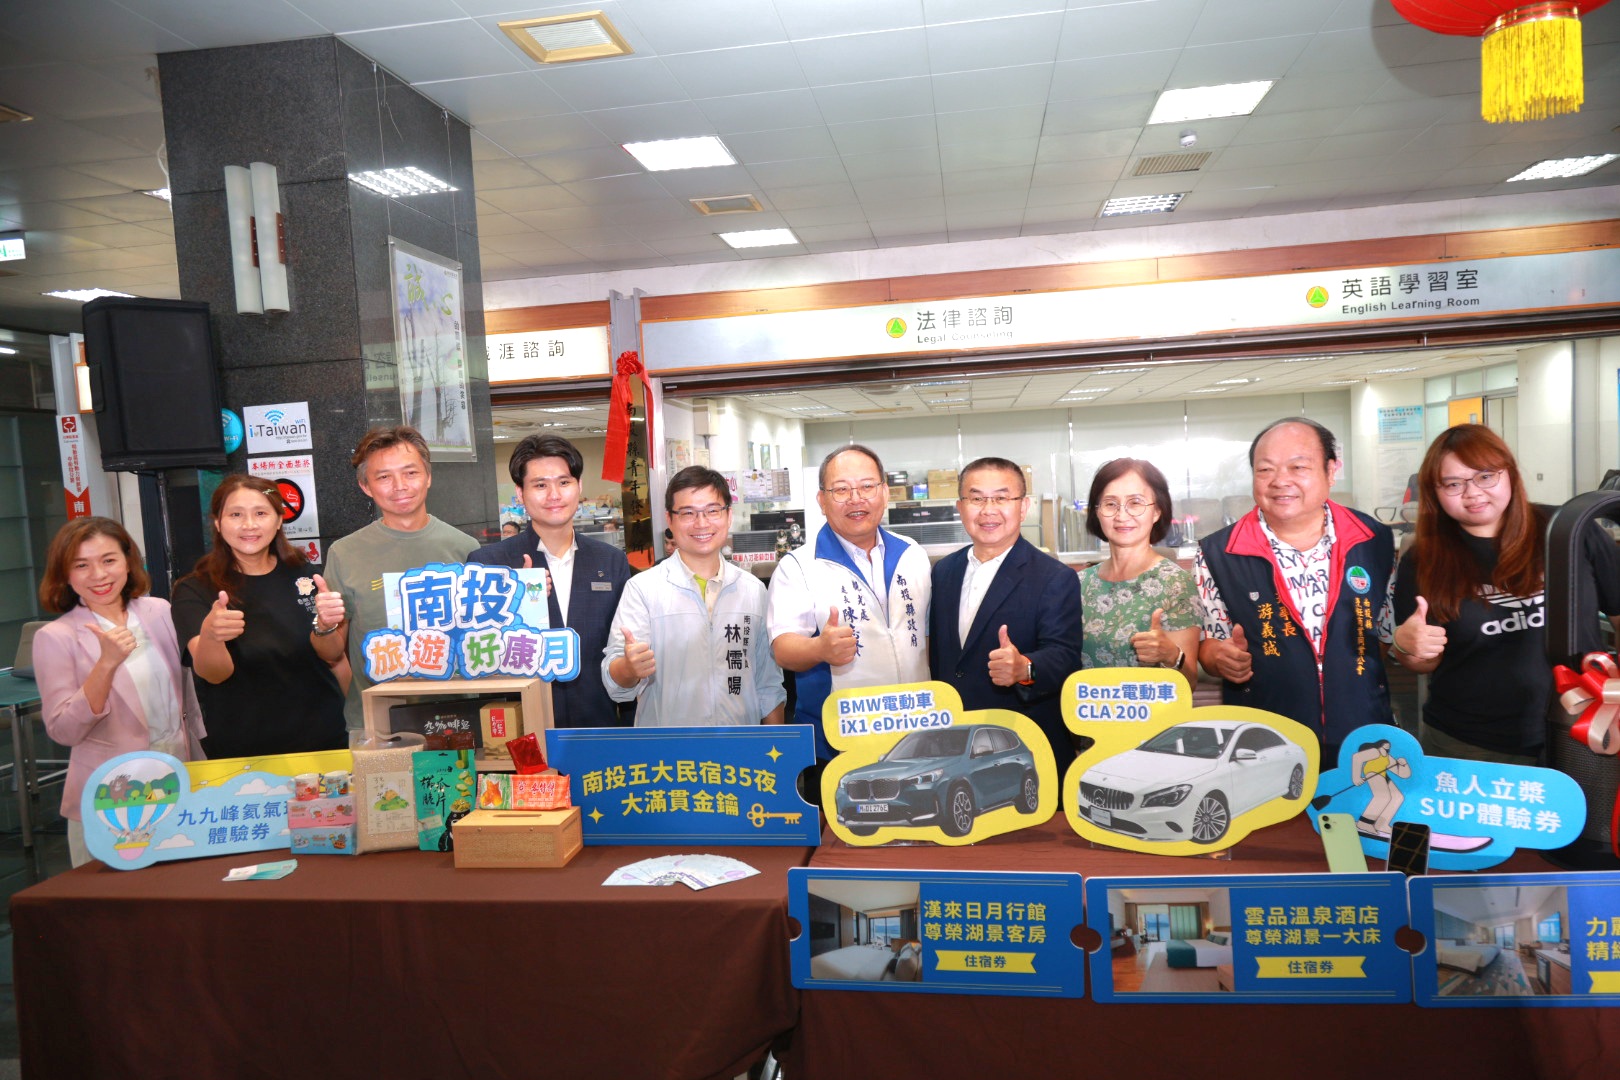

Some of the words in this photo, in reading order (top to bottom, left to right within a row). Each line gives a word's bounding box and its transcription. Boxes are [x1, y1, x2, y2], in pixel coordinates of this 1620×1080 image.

[1342, 269, 1478, 299] 英語學習室
[1342, 303, 1386, 315] English
[1391, 299, 1441, 310] Learning
[1447, 297, 1480, 307] Room
[917, 306, 1013, 331] 法律諮詢
[917, 334, 946, 344] Legal
[252, 459, 310, 470] 本場所全面禁菸
[405, 570, 511, 631] 南投
[896, 573, 918, 647] 南投縣政府
[1257, 602, 1280, 657] 游義誠
[1078, 684, 1174, 700] Benz電動車
[840, 692, 933, 715] BMW電動車
[1078, 705, 1111, 719] CLA
[1116, 705, 1148, 719] 200
[841, 719, 868, 734] iX1
[873, 711, 951, 731] eDrive20
[581, 760, 778, 797] 南投五大民宿35夜
[1434, 771, 1546, 805] 魚人立槳
[621, 789, 740, 817] 大滿貫金鑰
[1420, 797, 1562, 834] SUP體驗券
[208, 824, 270, 845] 體驗券
[923, 900, 1047, 922] 漢來日月行館
[1243, 906, 1380, 926] 雲品溫泉酒店
[924, 923, 1047, 944] 尊榮湖景客房
[1245, 928, 1382, 946] 尊榮湖景一大床
[964, 955, 1007, 969] 住宿券
[1287, 960, 1335, 975] 住宿券
